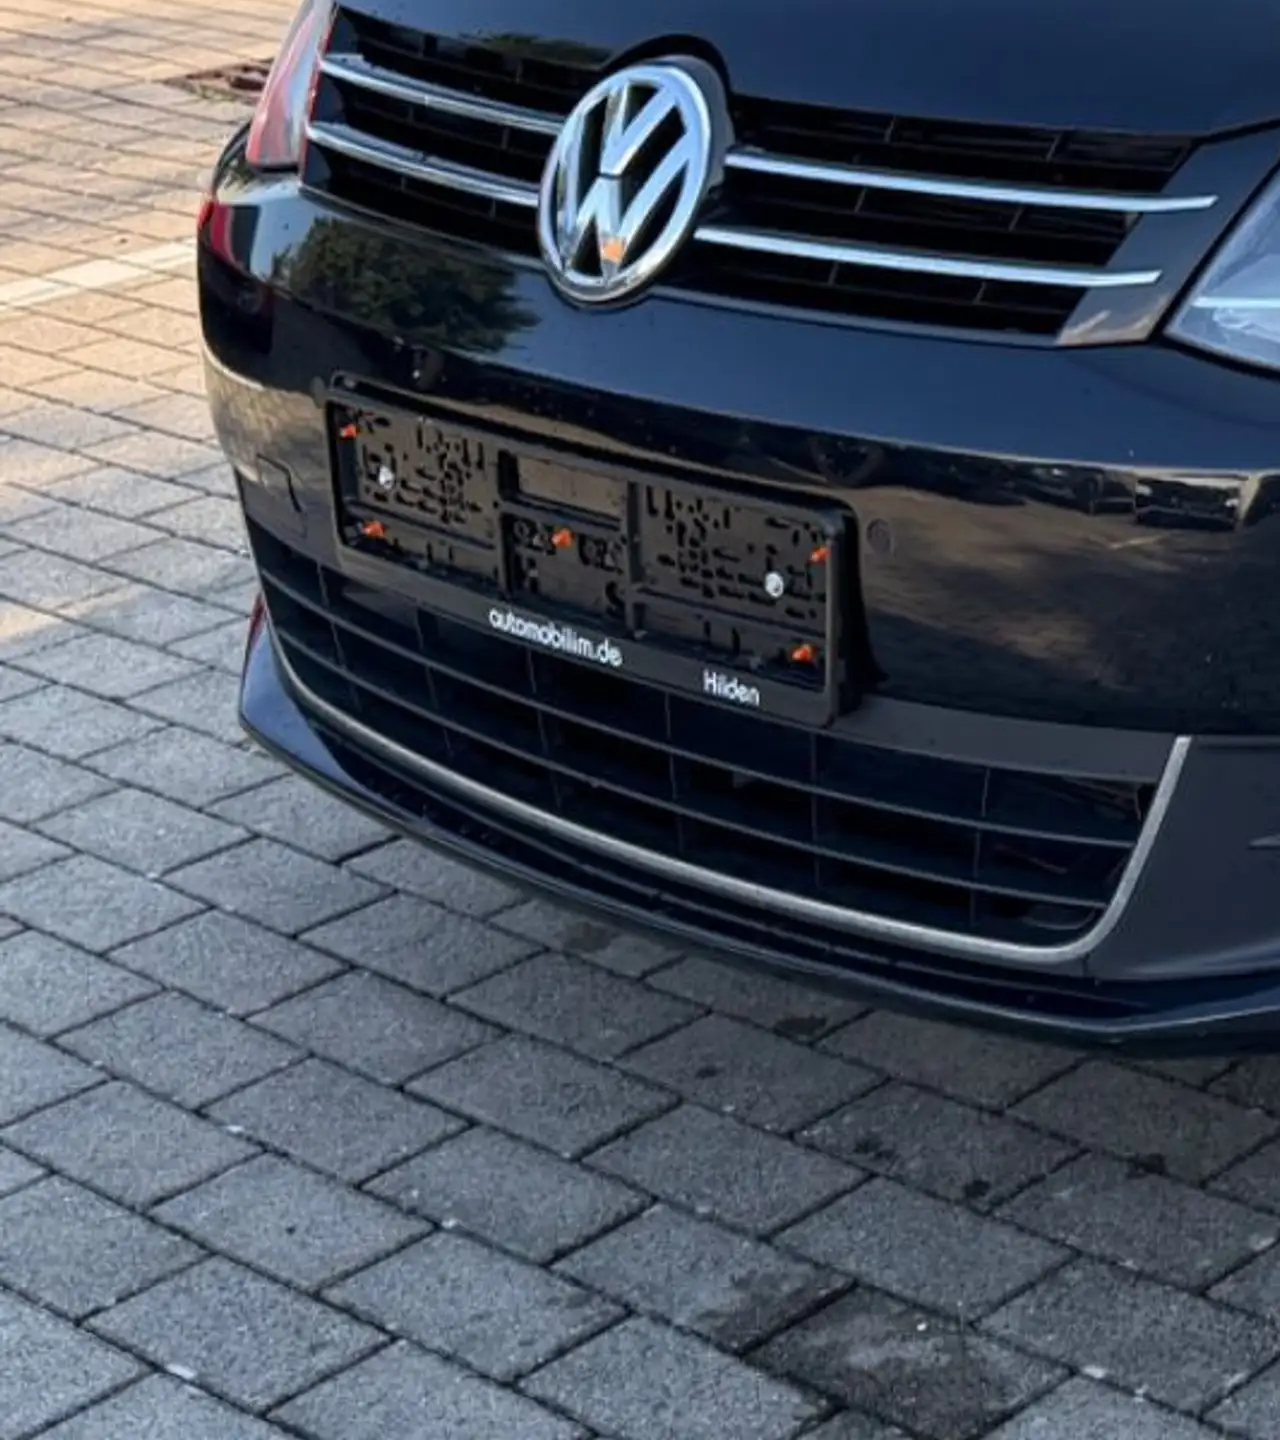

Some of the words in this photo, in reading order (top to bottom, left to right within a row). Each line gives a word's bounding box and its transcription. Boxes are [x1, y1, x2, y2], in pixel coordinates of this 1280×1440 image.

[541, 65, 711, 302] VW
[489, 609, 622, 667] automobilim.de
[703, 669, 760, 706] Hilden
